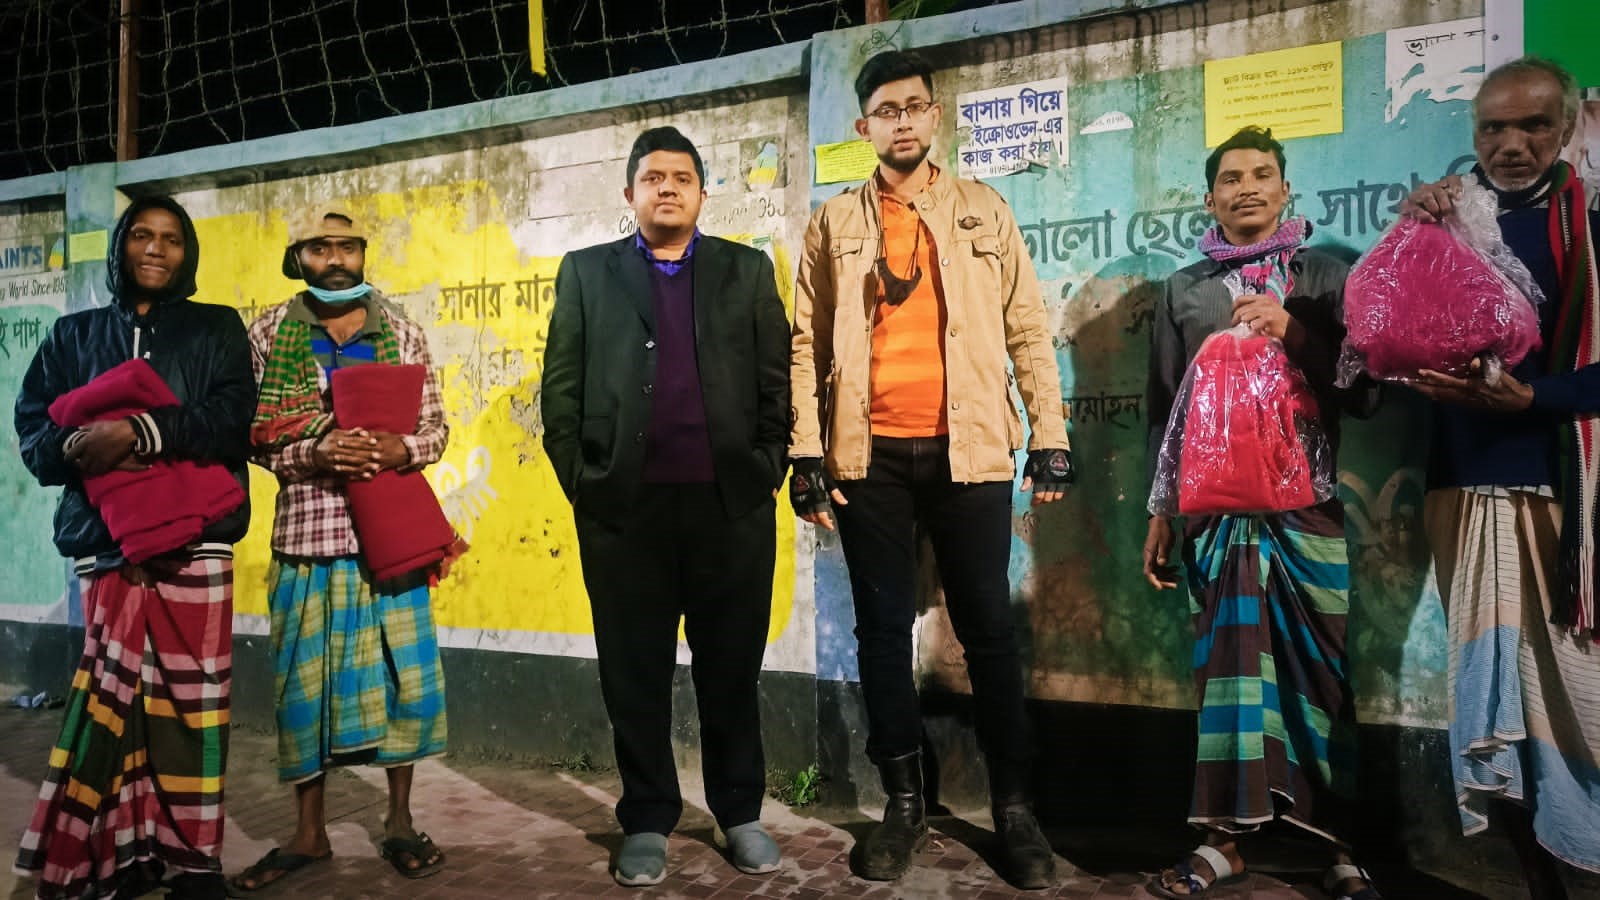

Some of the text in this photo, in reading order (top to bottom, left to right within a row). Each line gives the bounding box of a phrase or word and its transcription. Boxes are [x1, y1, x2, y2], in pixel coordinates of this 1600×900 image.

[960, 88, 1064, 123] বাসায় গিয়ে
[961, 148, 994, 167] কাজ
[996, 142, 1027, 161] করা
[0, 246, 42, 270] INTS
[9, 279, 29, 300] World
[31, 279, 51, 297] Since
